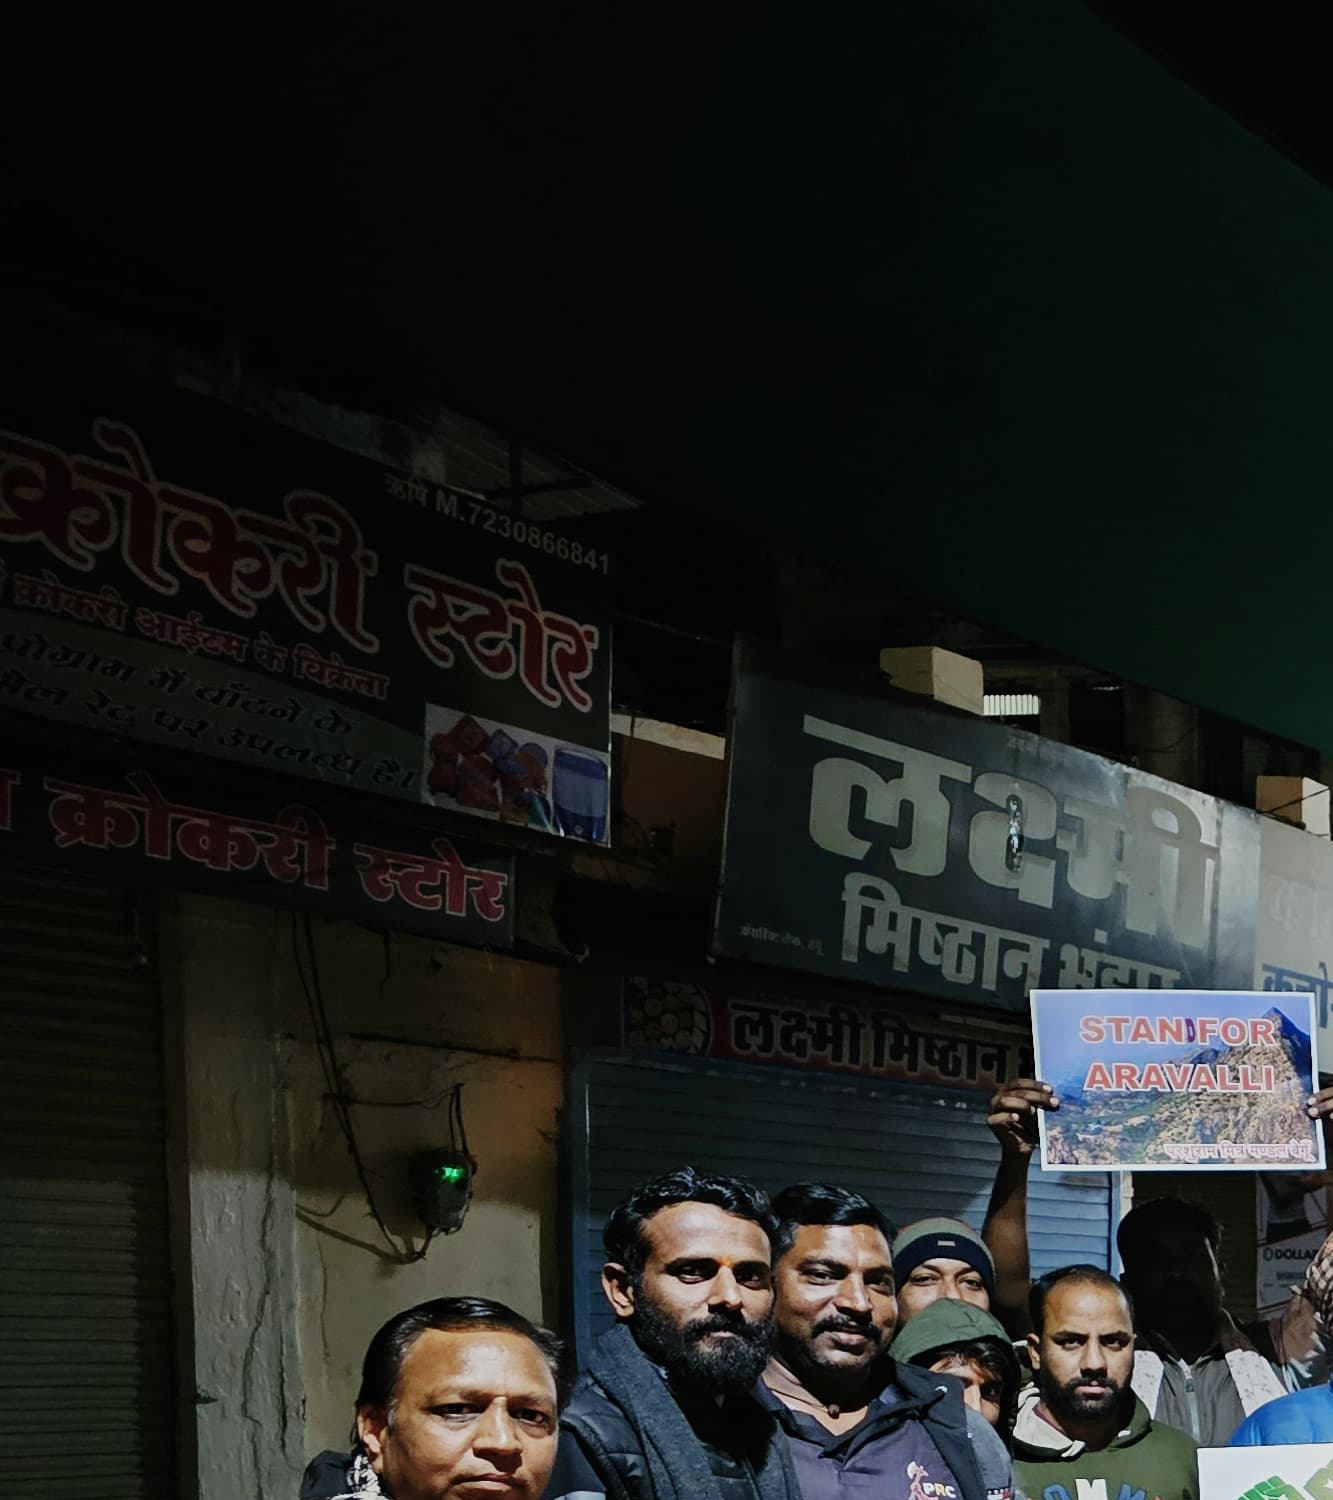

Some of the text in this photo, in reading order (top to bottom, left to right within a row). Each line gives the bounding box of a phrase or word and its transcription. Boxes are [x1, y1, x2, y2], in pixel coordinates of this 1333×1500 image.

[404, 557, 599, 713] स्टोर
[43, 768, 336, 891] क्रोकरी
[353, 837, 508, 922] स्टोर
[840, 872, 1050, 997] मिष्ठान
[1083, 1062, 1275, 1093] ARAVALLI
[1196, 1016, 1277, 1046] FOR
